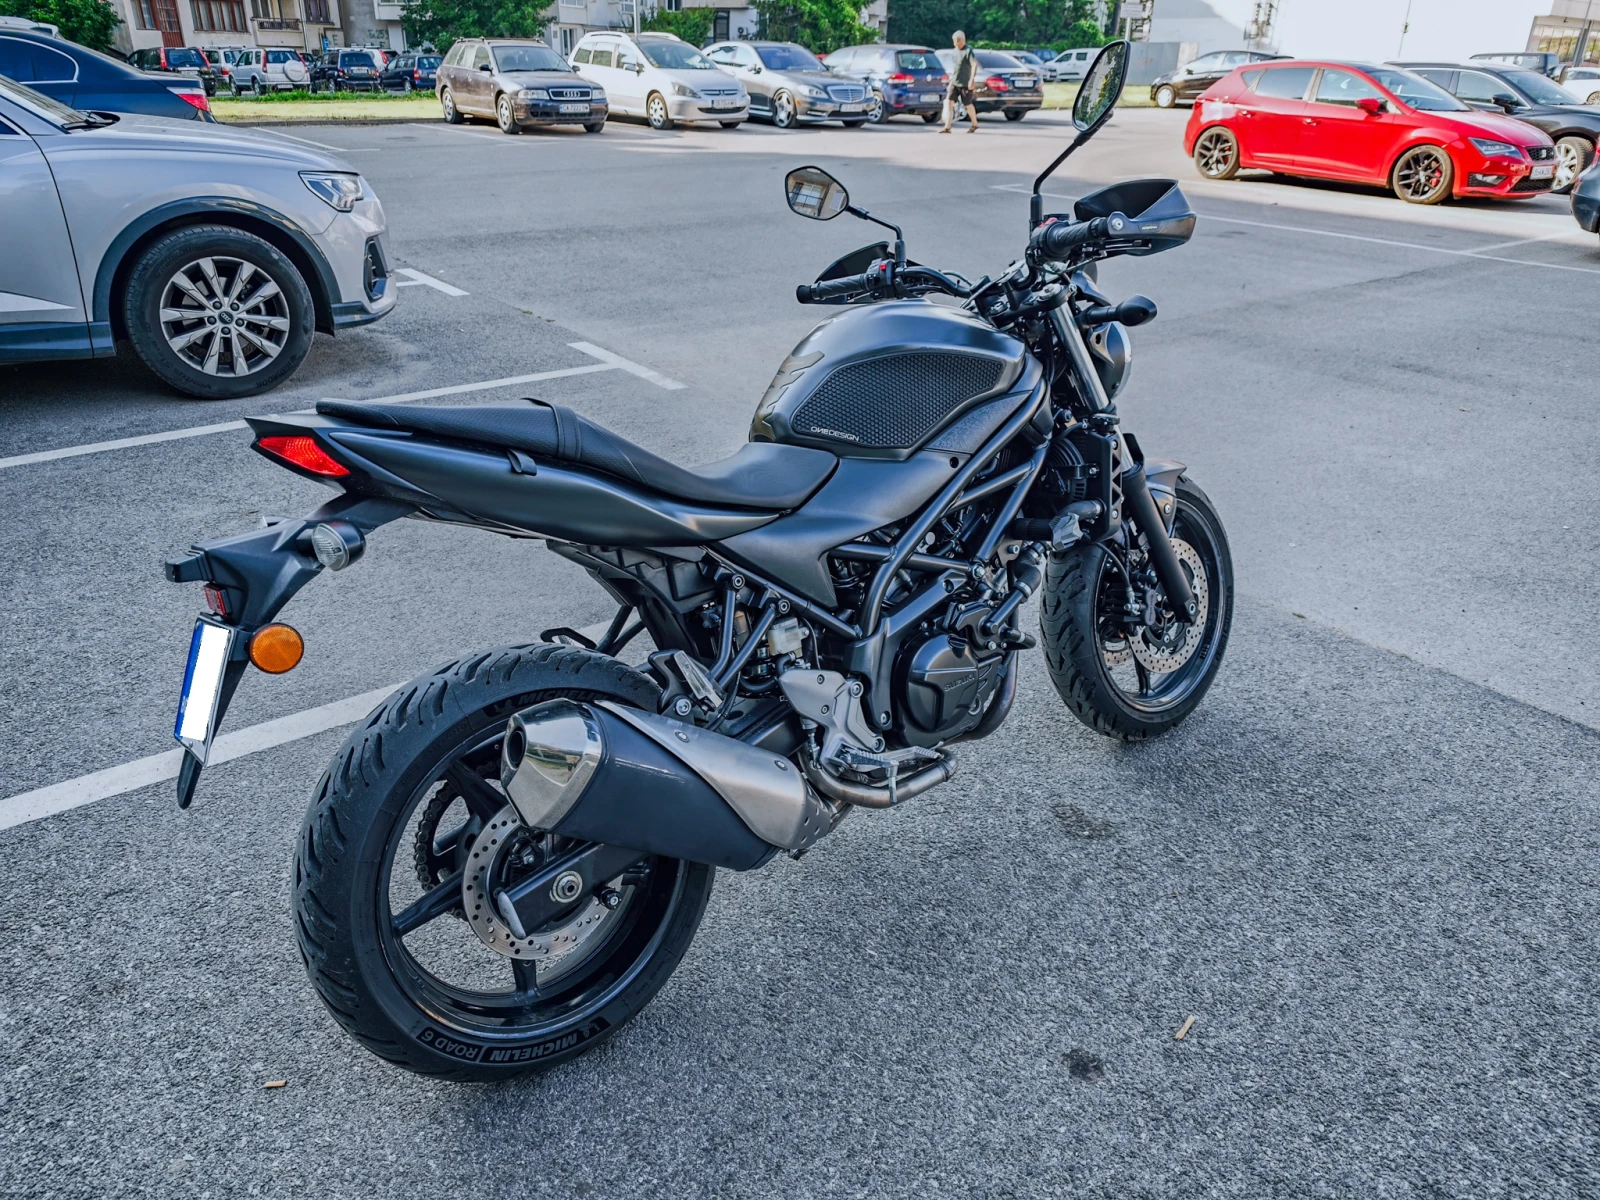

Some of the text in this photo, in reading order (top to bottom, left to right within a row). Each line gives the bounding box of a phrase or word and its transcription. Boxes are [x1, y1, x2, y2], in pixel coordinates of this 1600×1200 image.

[944, 674, 975, 692] SUZUKI
[518, 690, 608, 705] MICHELIN
[422, 1031, 578, 1061] MICHELIN ROAD 6
